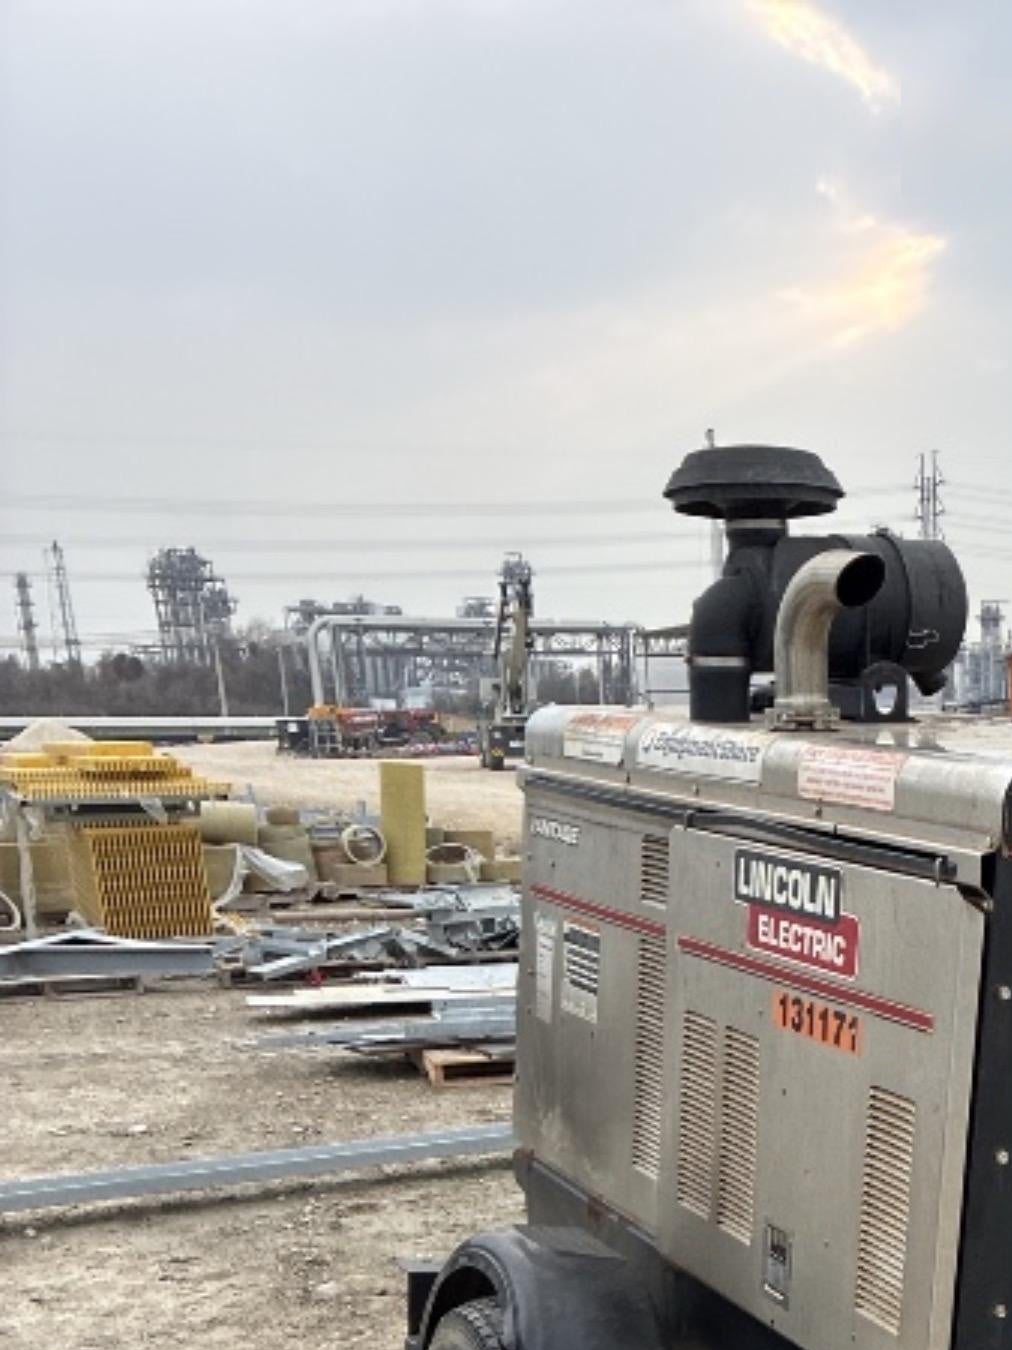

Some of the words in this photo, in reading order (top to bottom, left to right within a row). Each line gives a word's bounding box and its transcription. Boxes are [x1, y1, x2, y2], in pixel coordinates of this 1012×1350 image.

[738, 856, 835, 919] LINCOLN
[757, 913, 847, 967] ELECTRIC
[779, 993, 859, 1052] 131171
